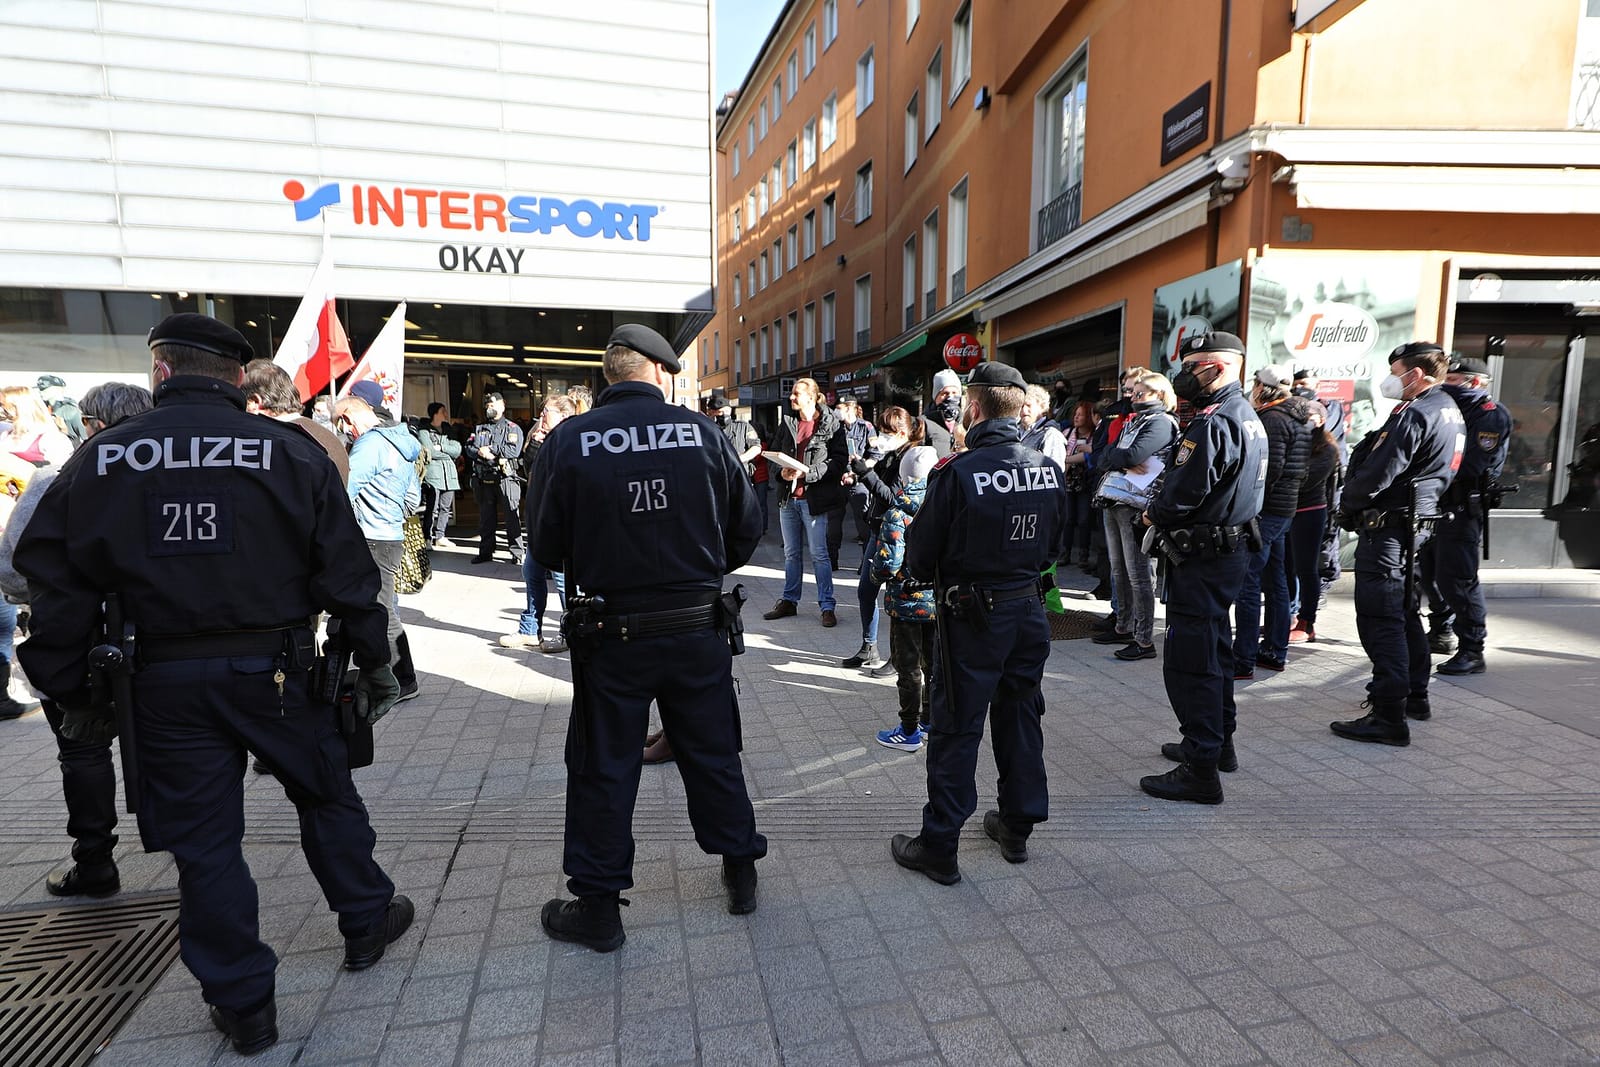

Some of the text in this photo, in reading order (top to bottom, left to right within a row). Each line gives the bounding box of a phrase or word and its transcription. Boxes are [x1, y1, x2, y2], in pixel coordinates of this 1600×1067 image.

[352, 184, 658, 241] INTERSPORT
[438, 244, 525, 274] OKAY
[1294, 313, 1369, 350] Segafredo
[946, 345, 979, 357] Coca-Cola
[97, 437, 272, 476] POLIZEI
[580, 423, 703, 457] POLIZEI
[628, 478, 668, 513] 213
[972, 466, 1059, 495] POLIZEI
[162, 503, 217, 541] 213
[1010, 514, 1037, 541] 213
